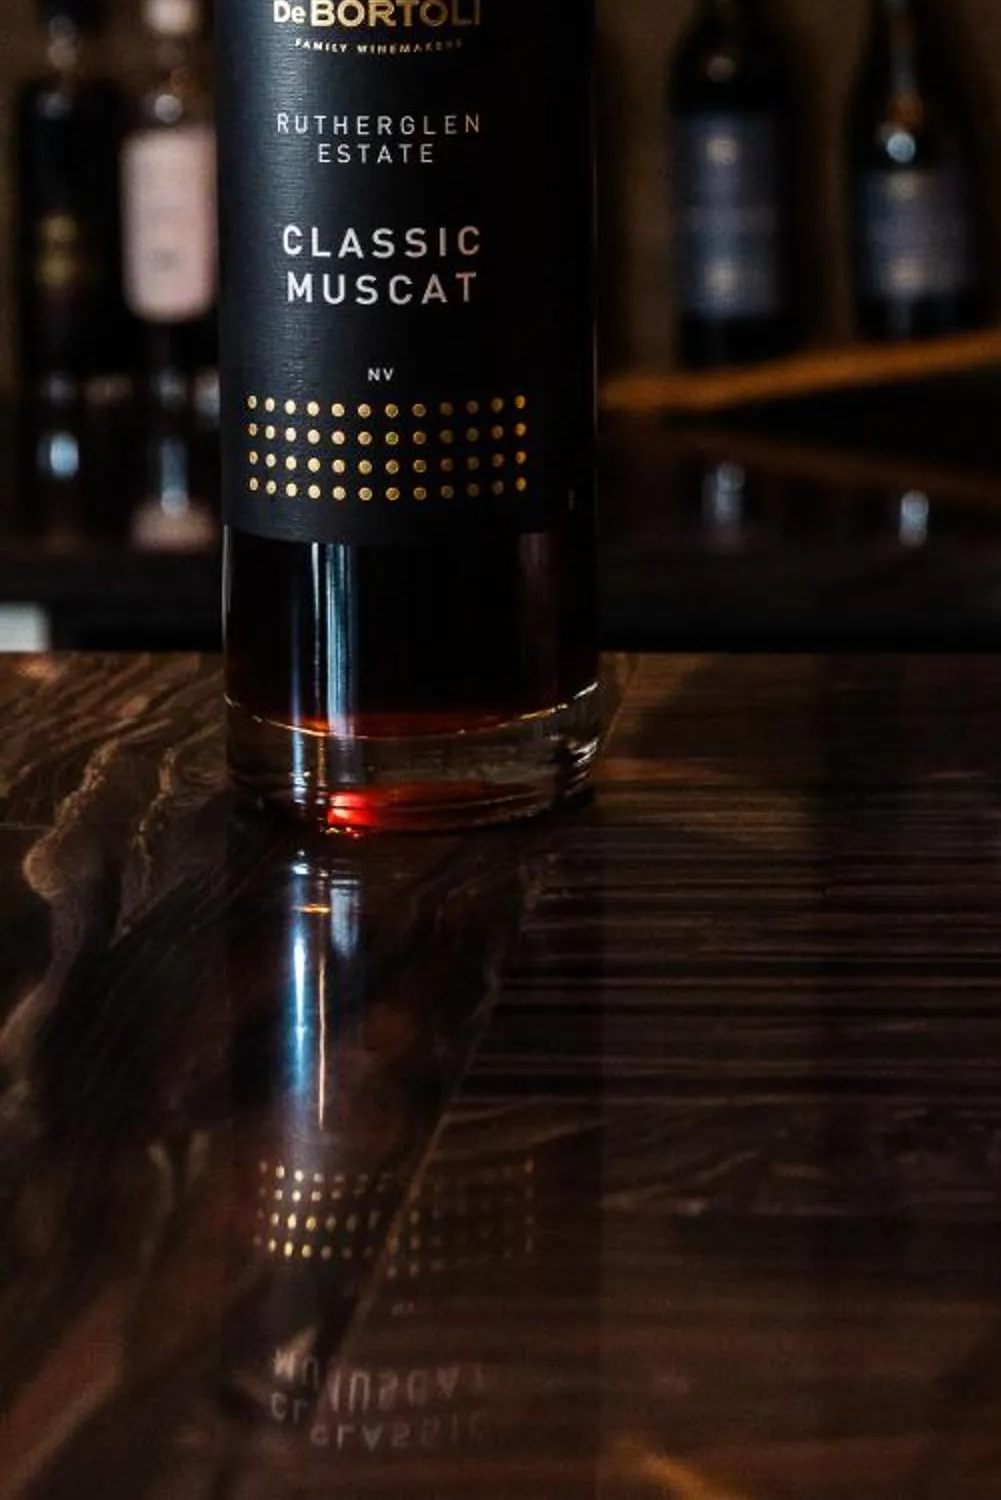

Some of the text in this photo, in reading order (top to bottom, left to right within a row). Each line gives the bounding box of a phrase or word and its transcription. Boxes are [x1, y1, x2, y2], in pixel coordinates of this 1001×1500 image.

[295, 37, 464, 55] FAMILY WINEMAKERS
[276, 112, 481, 136] RUTHERGLEN
[317, 143, 435, 164] ESTATE
[282, 225, 482, 259] CLASSIC
[286, 271, 478, 305] MUSCAT
[367, 367, 395, 382] NV
